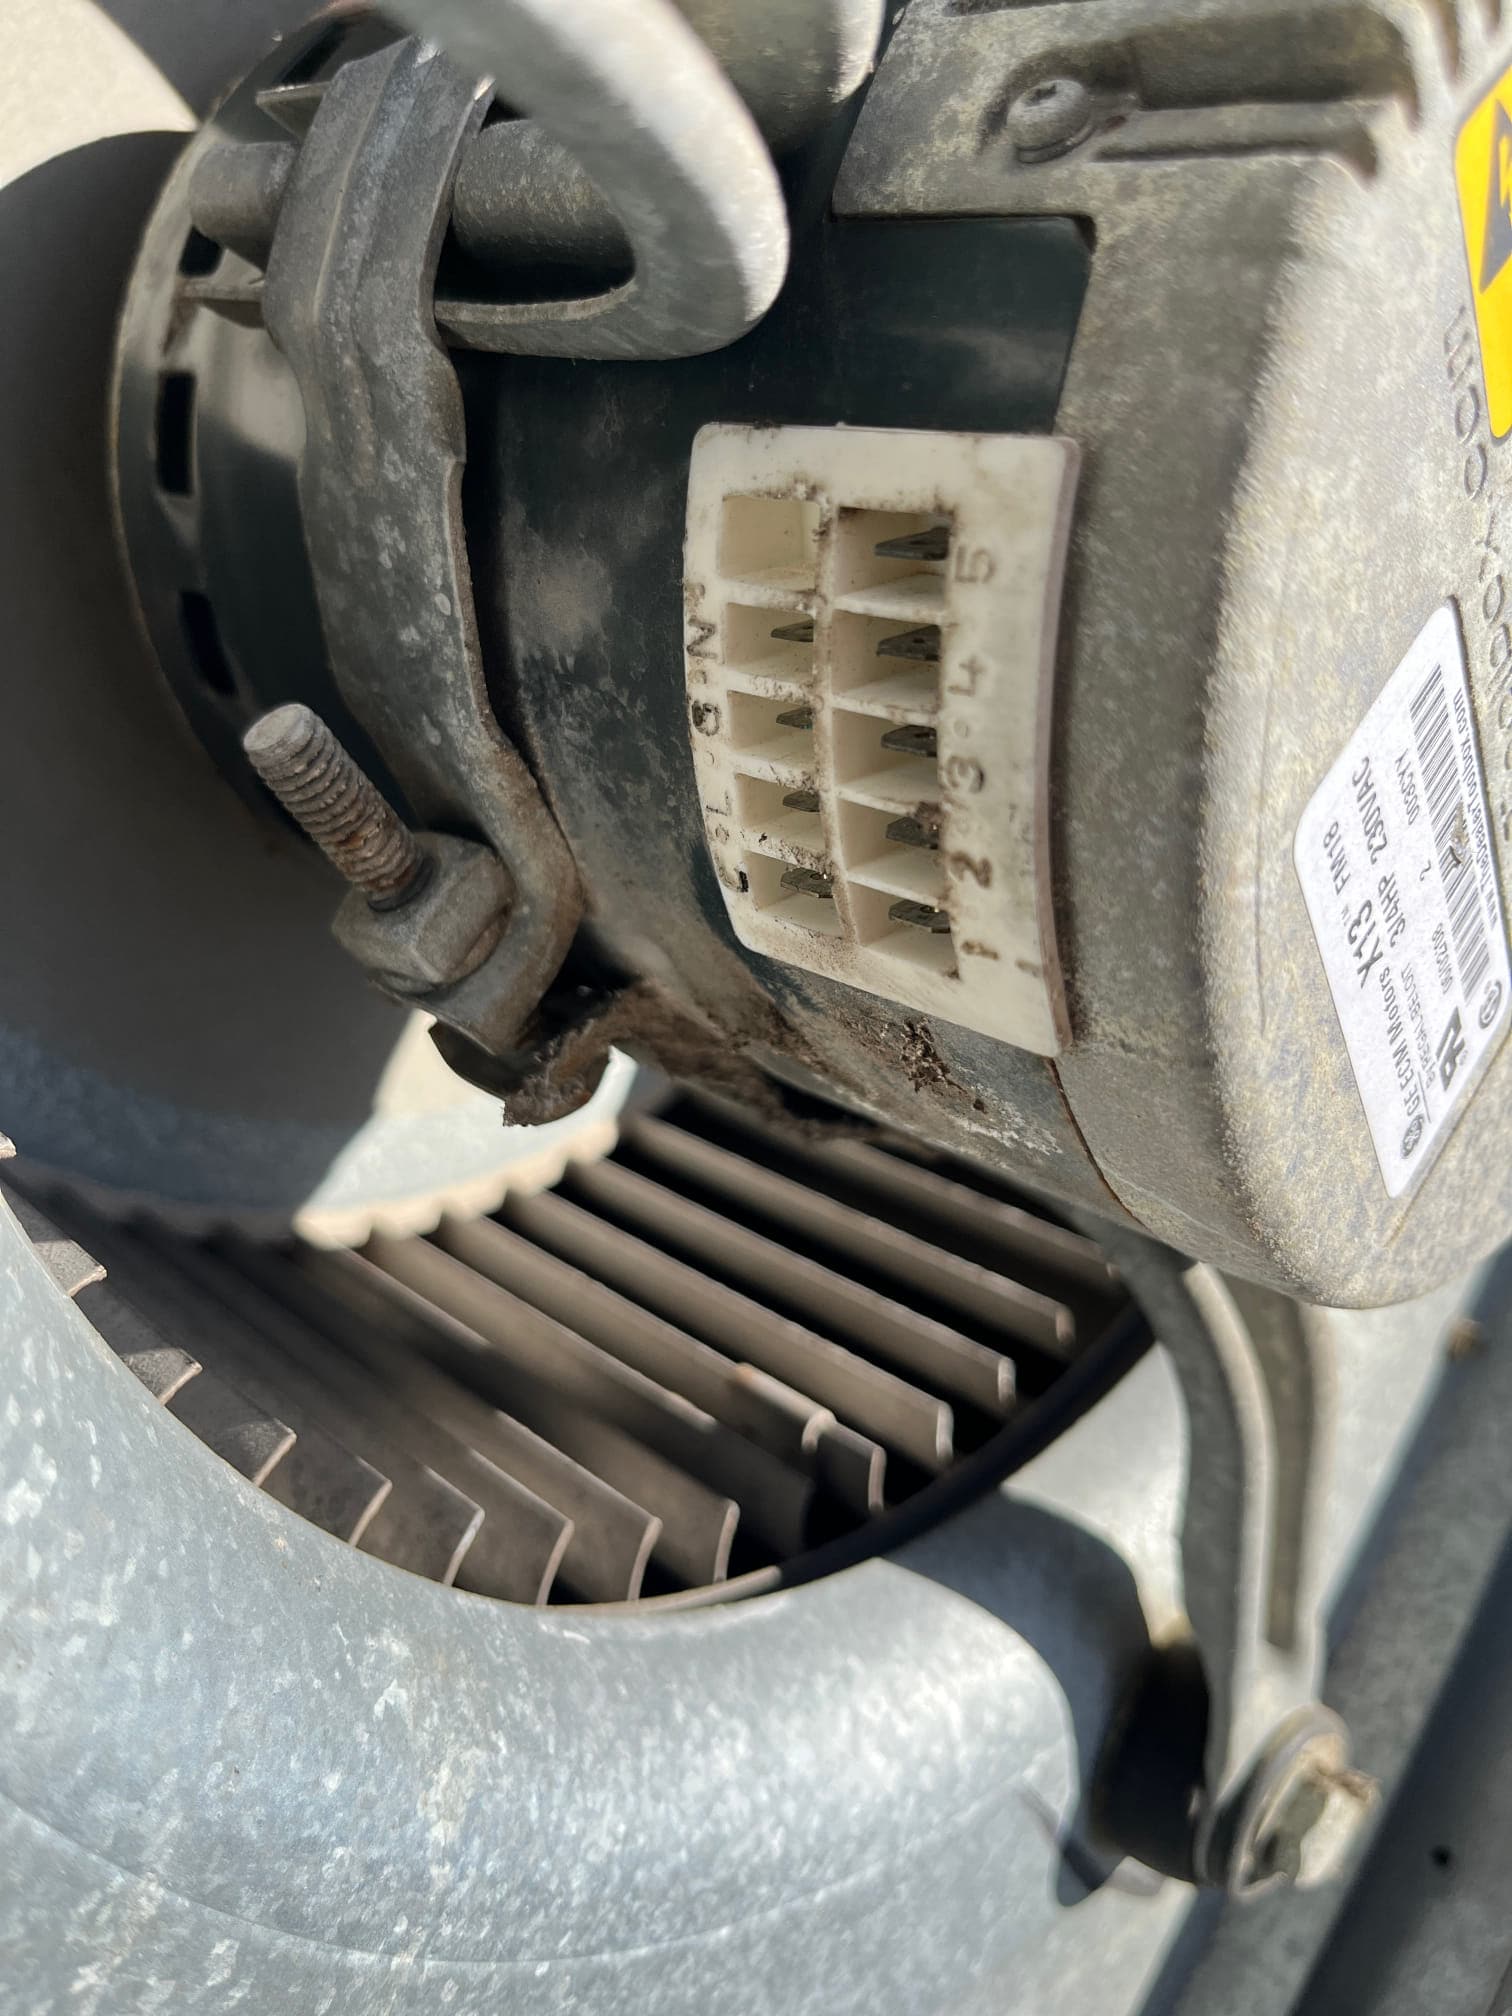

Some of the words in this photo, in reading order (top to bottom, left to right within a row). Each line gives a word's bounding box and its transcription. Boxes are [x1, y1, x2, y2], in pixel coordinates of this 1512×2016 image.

[955, 546, 996, 584] 5
[687, 621, 718, 660] N
[948, 654, 988, 697] 4
[945, 756, 985, 794] 3
[1394, 747, 1420, 826] 003CYY
[1351, 755, 1388, 866] 230VAC
[1452, 686, 1498, 930] www.TheDealerToolbox.com
[948, 851, 993, 889] 2
[1321, 819, 1351, 896] FM18
[1418, 859, 1431, 882] 2
[1377, 871, 1406, 949] 3/4HP
[960, 941, 1000, 961] 1
[1379, 964, 1403, 1046] Motors
[1392, 1037, 1414, 1091] ECM
[1403, 1083, 1421, 1118] GE
